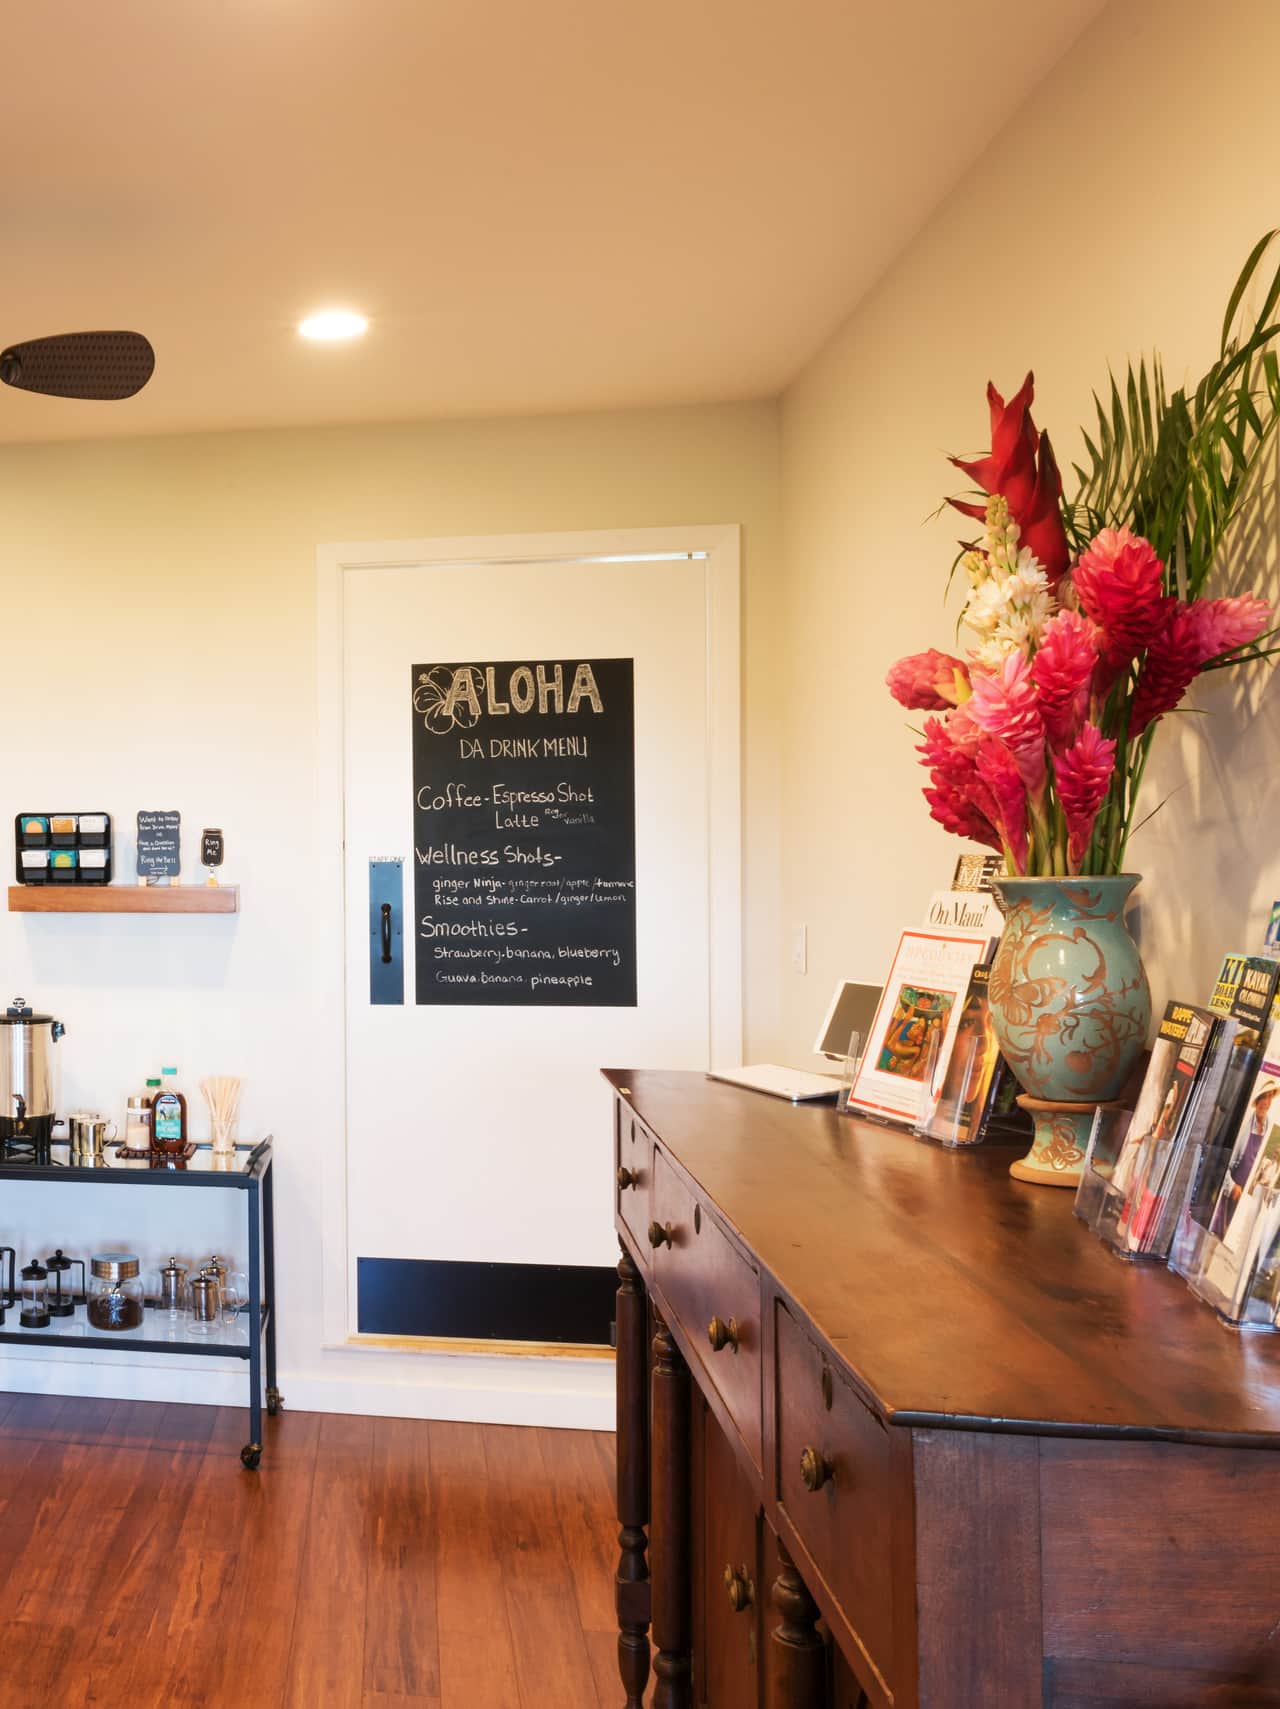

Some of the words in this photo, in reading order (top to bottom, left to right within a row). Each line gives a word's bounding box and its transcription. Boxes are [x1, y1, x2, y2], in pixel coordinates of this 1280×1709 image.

[442, 664, 604, 715] ALOHA
[460, 738, 485, 759] DA
[490, 738, 540, 759] DRINK
[543, 736, 588, 758] MENU
[492, 783, 555, 811] Espresso
[557, 782, 595, 803] Shot
[495, 811, 539, 829] Latte
[205, 838, 219, 849] Ring
[415, 843, 499, 865] Wellness
[432, 876, 470, 892] ginger
[434, 894, 460, 906] Rise
[462, 895, 482, 905] and
[929, 902, 949, 925] On
[558, 946, 621, 966] blueberry
[531, 974, 593, 990] pineapple
